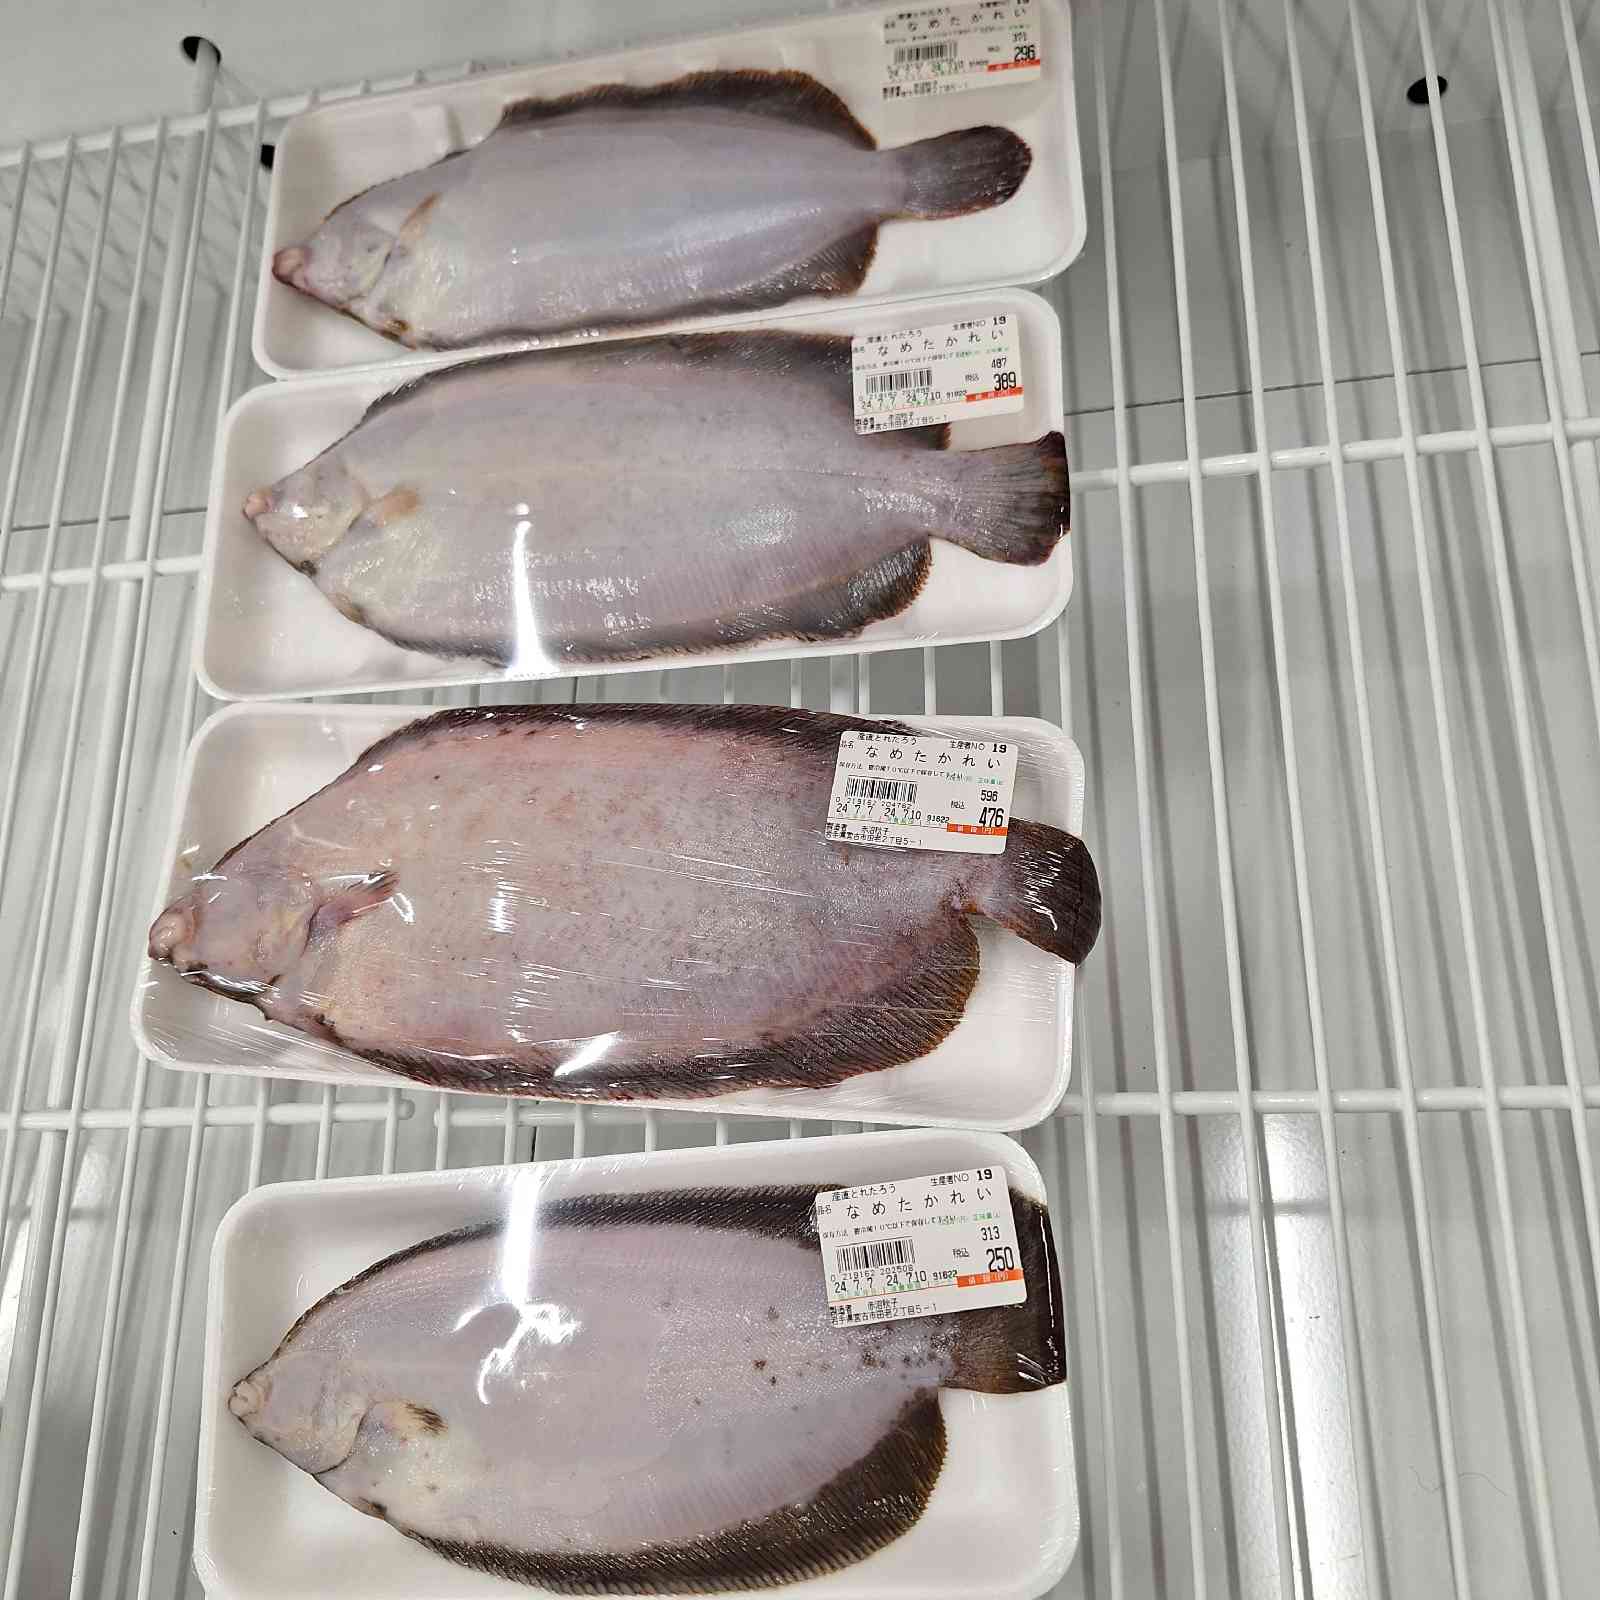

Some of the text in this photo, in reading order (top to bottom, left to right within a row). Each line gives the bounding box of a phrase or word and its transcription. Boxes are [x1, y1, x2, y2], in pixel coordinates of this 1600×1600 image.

[1014, 45, 1036, 61] 296
[993, 316, 1006, 325] 19
[878, 330, 1003, 356] なめたかれい
[992, 358, 1006, 368] 487
[994, 372, 1017, 391] 389
[840, 741, 854, 749] 品名
[858, 733, 917, 745] 産直とれたろう
[950, 740, 1006, 753] 生産者NO 19
[866, 746, 1000, 768] なめたかれい
[981, 790, 998, 801] 596
[836, 804, 847, 812] 24
[884, 809, 896, 817] 24
[927, 815, 949, 823] 91622
[951, 801, 1004, 827] 税込 476
[930, 1169, 993, 1185] 生産者NO 19
[832, 1184, 896, 1201] 産直とれたろう
[818, 1205, 831, 1215] 品名
[847, 1188, 991, 1219] なめたかれい
[981, 1227, 999, 1240] 313
[953, 1247, 1014, 1273] 税込 250
[933, 1271, 957, 1280] 91622
